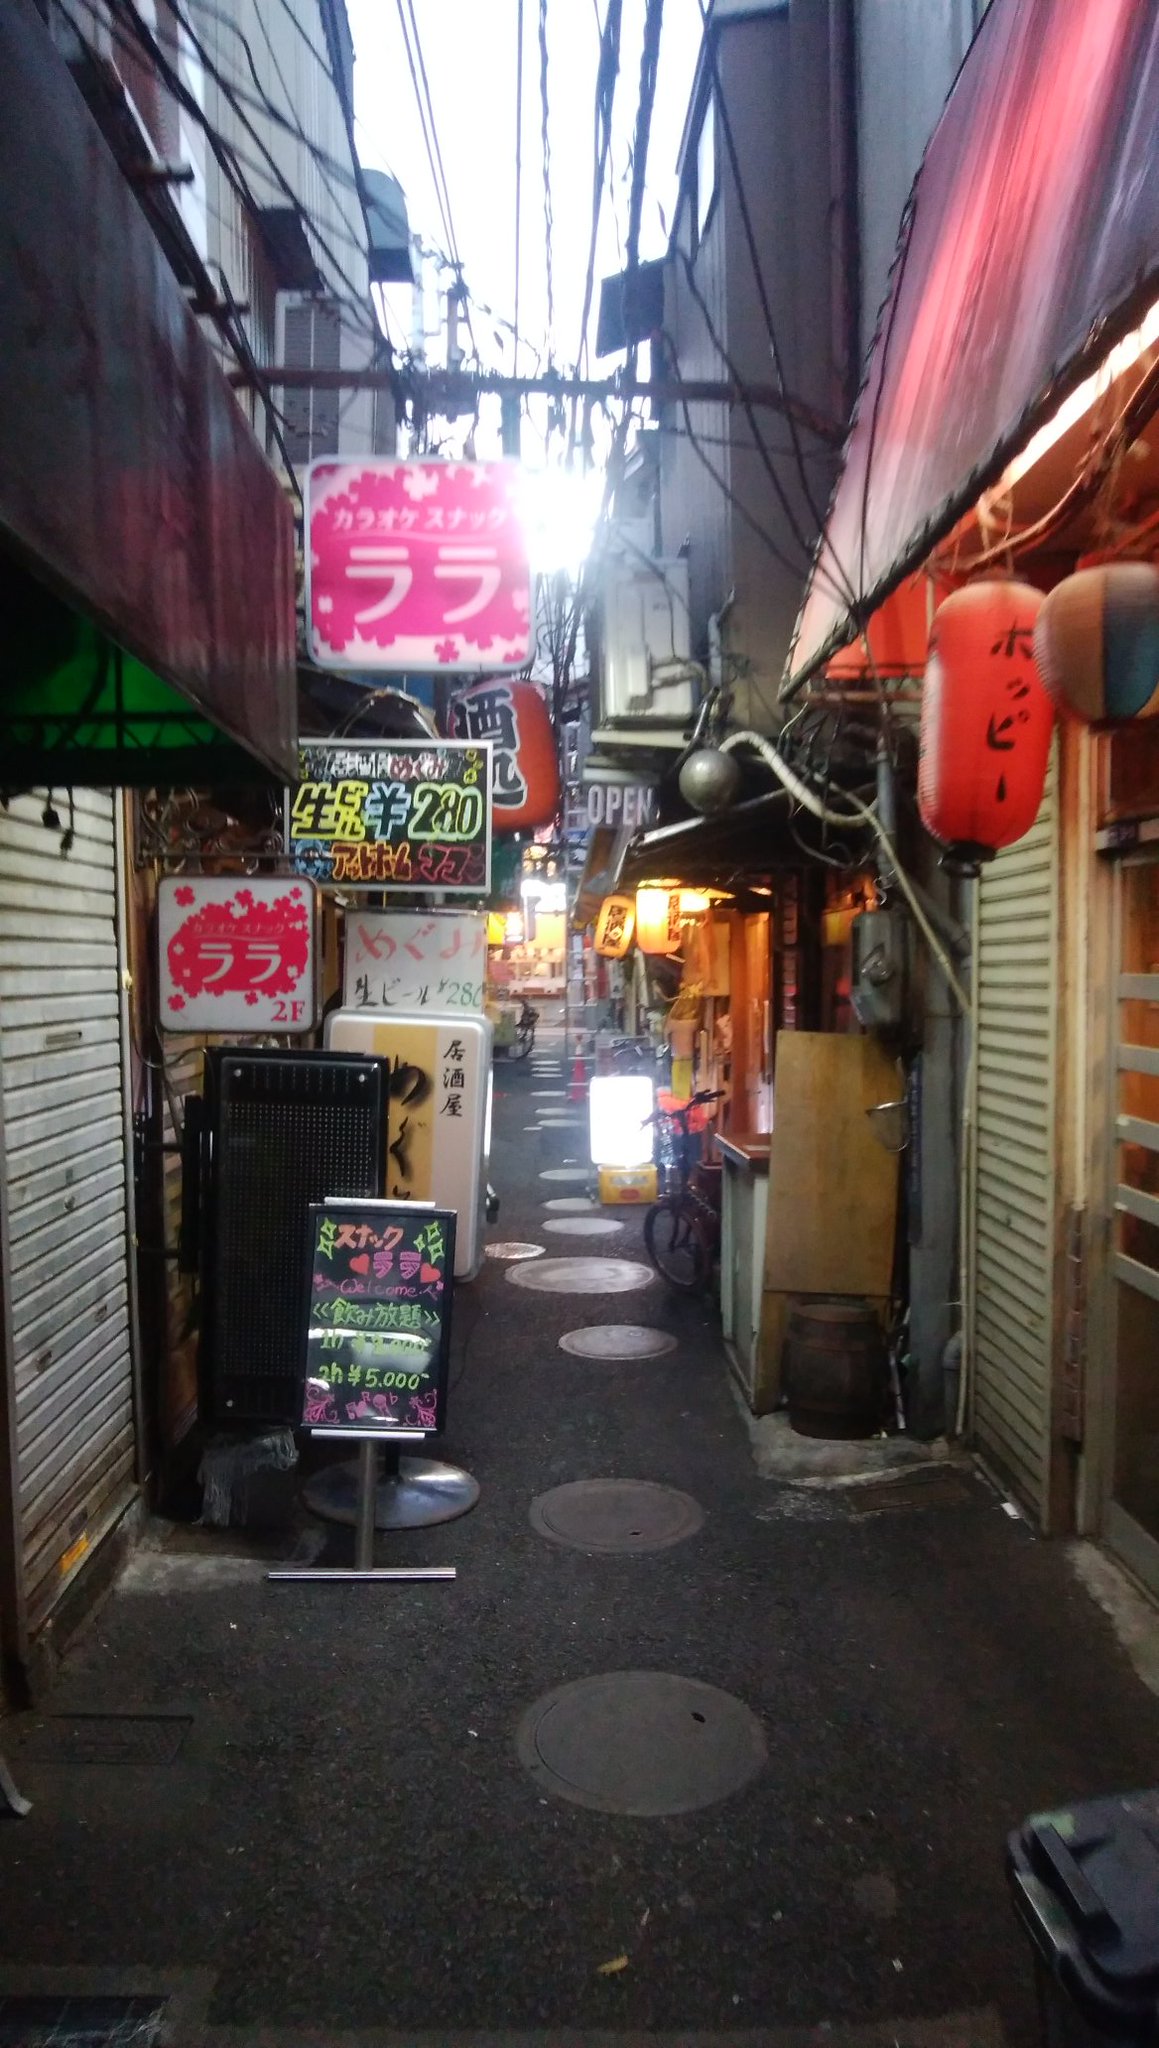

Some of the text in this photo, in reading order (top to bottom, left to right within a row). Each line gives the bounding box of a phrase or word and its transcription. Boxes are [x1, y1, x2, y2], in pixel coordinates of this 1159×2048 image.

[332, 507, 507, 530] カラオケ スナック
[345, 546, 502, 623] ララ
[587, 784, 653, 825] OPEN
[197, 943, 282, 984] ララ
[271, 1001, 305, 1022] 2F
[439, 1039, 466, 1118] 居酒屋
[334, 1223, 404, 1251] スナック
[372, 1251, 422, 1280] ララ
[319, 1361, 343, 1384] 2h
